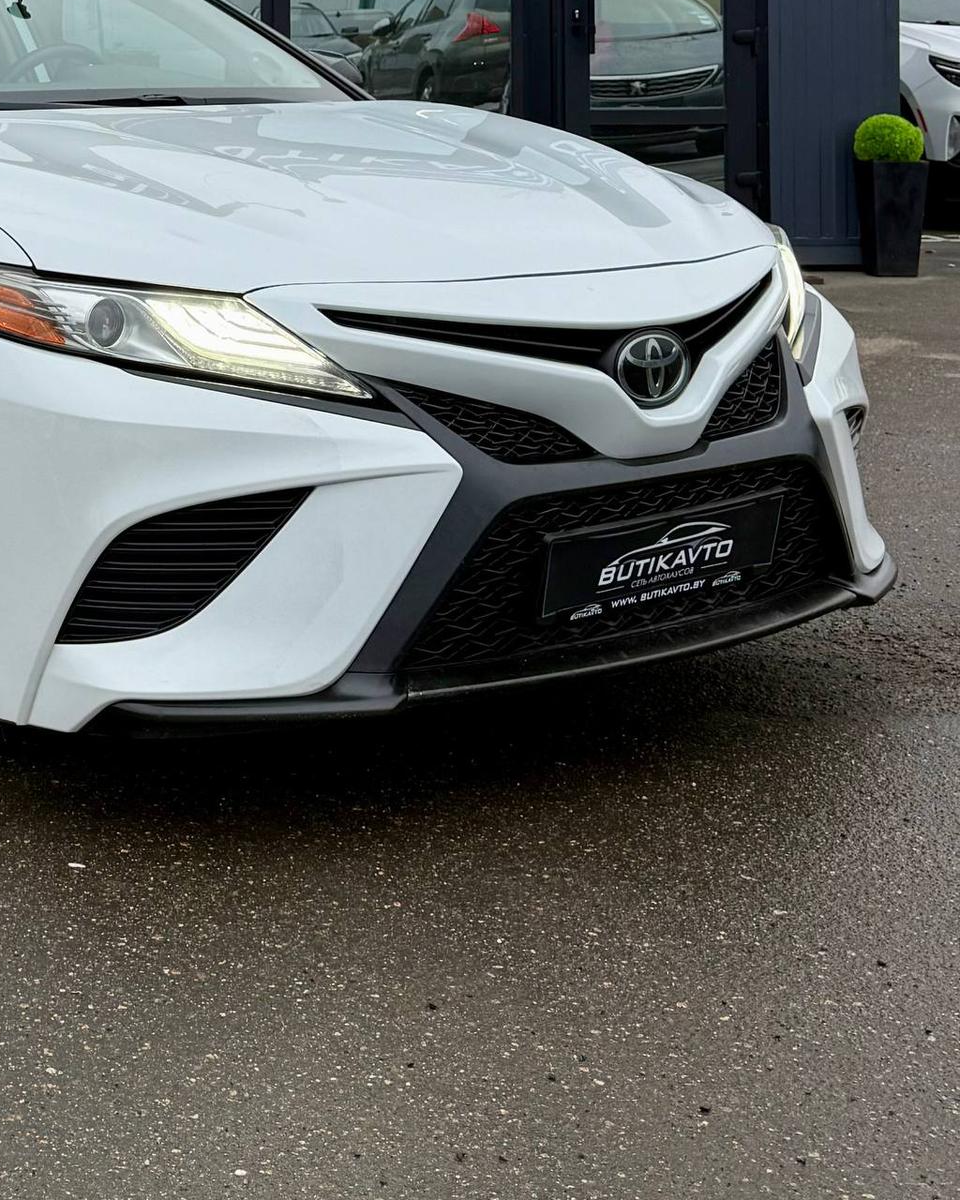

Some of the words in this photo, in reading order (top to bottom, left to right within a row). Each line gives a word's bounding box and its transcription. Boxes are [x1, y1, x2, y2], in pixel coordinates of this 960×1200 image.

[597, 539, 734, 587] BUTIKAVTO
[611, 595, 638, 609] WWW.
[640, 579, 706, 602] BUTIKAVTO.BY
